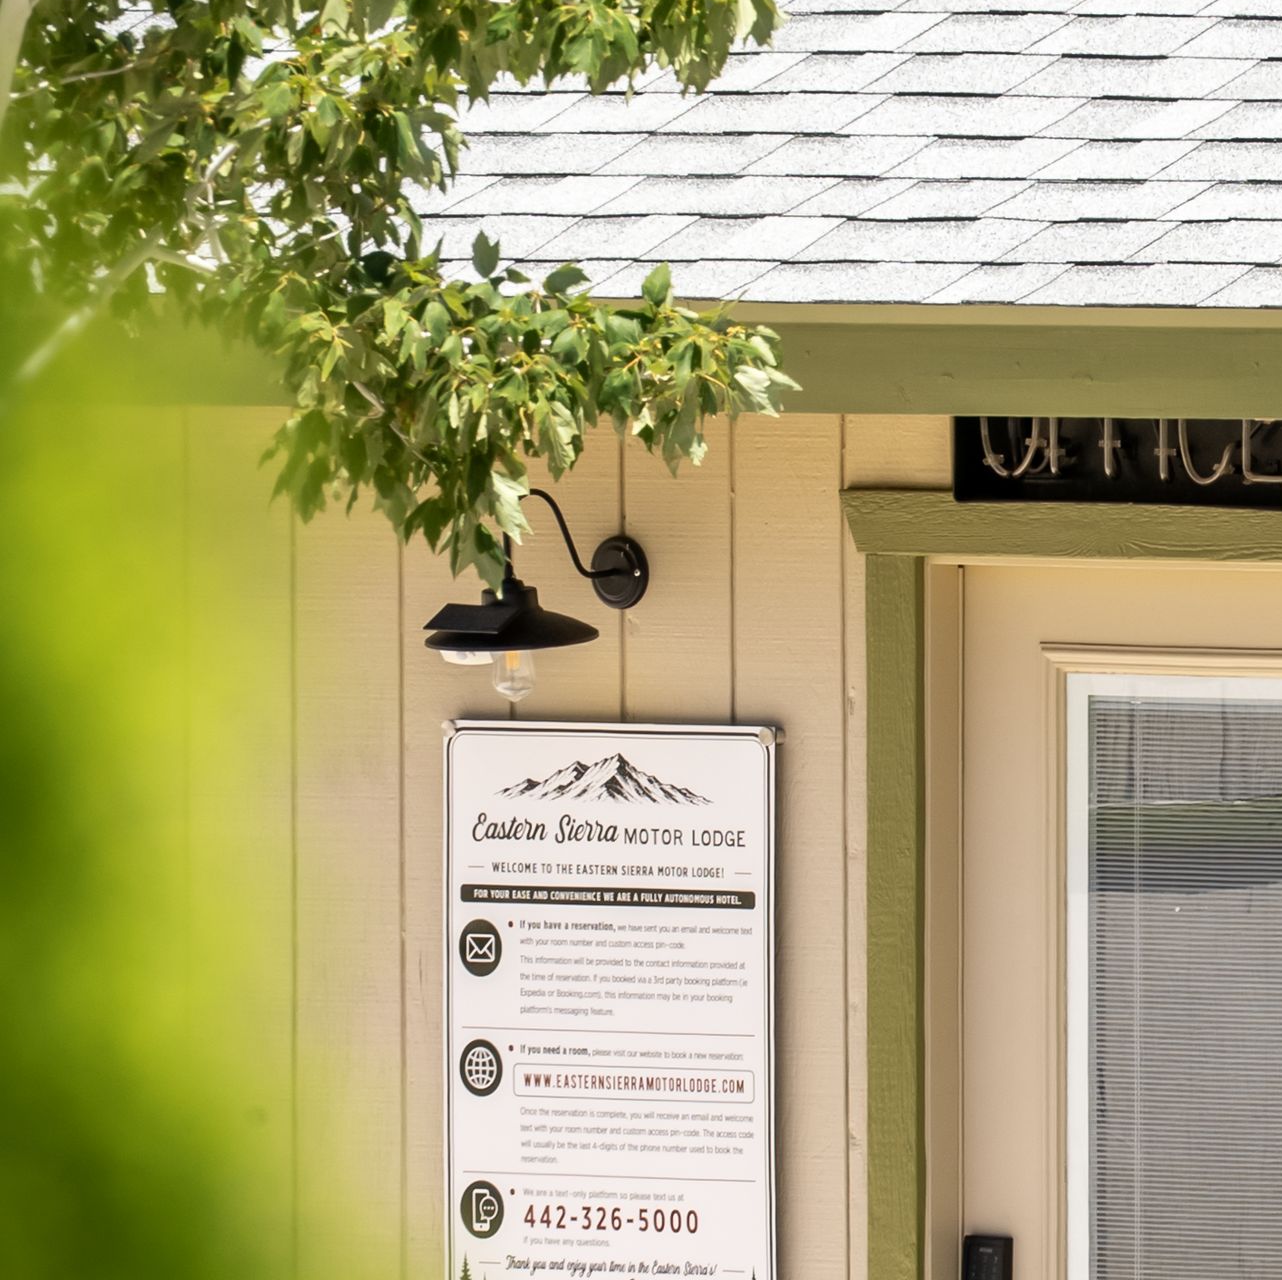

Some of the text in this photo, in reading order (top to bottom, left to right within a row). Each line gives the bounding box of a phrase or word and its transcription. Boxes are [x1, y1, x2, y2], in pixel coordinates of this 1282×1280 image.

[472, 812, 746, 847] Eastern Sierra MOTOR LODGE
[491, 862, 725, 878] WELCOME TO THE EASTERN SIERRA MOTOR LODGE!
[473, 889, 742, 905] FOR YOUR EASE AND CONVENIENCE WE ARE A FULLY AUTONOMOUS HOTEL.
[520, 920, 526, 928] If
[528, 921, 541, 930] you
[544, 920, 560, 929] have
[571, 921, 616, 933] reservation,
[520, 1045, 526, 1053] If
[528, 1046, 541, 1055] you
[542, 1045, 560, 1054] need
[568, 1048, 592, 1057] room,
[523, 1073, 745, 1094] WWW.EASTERNSIERRAMOTORLODGE.COM
[524, 1204, 698, 1233] 442-326-5000
